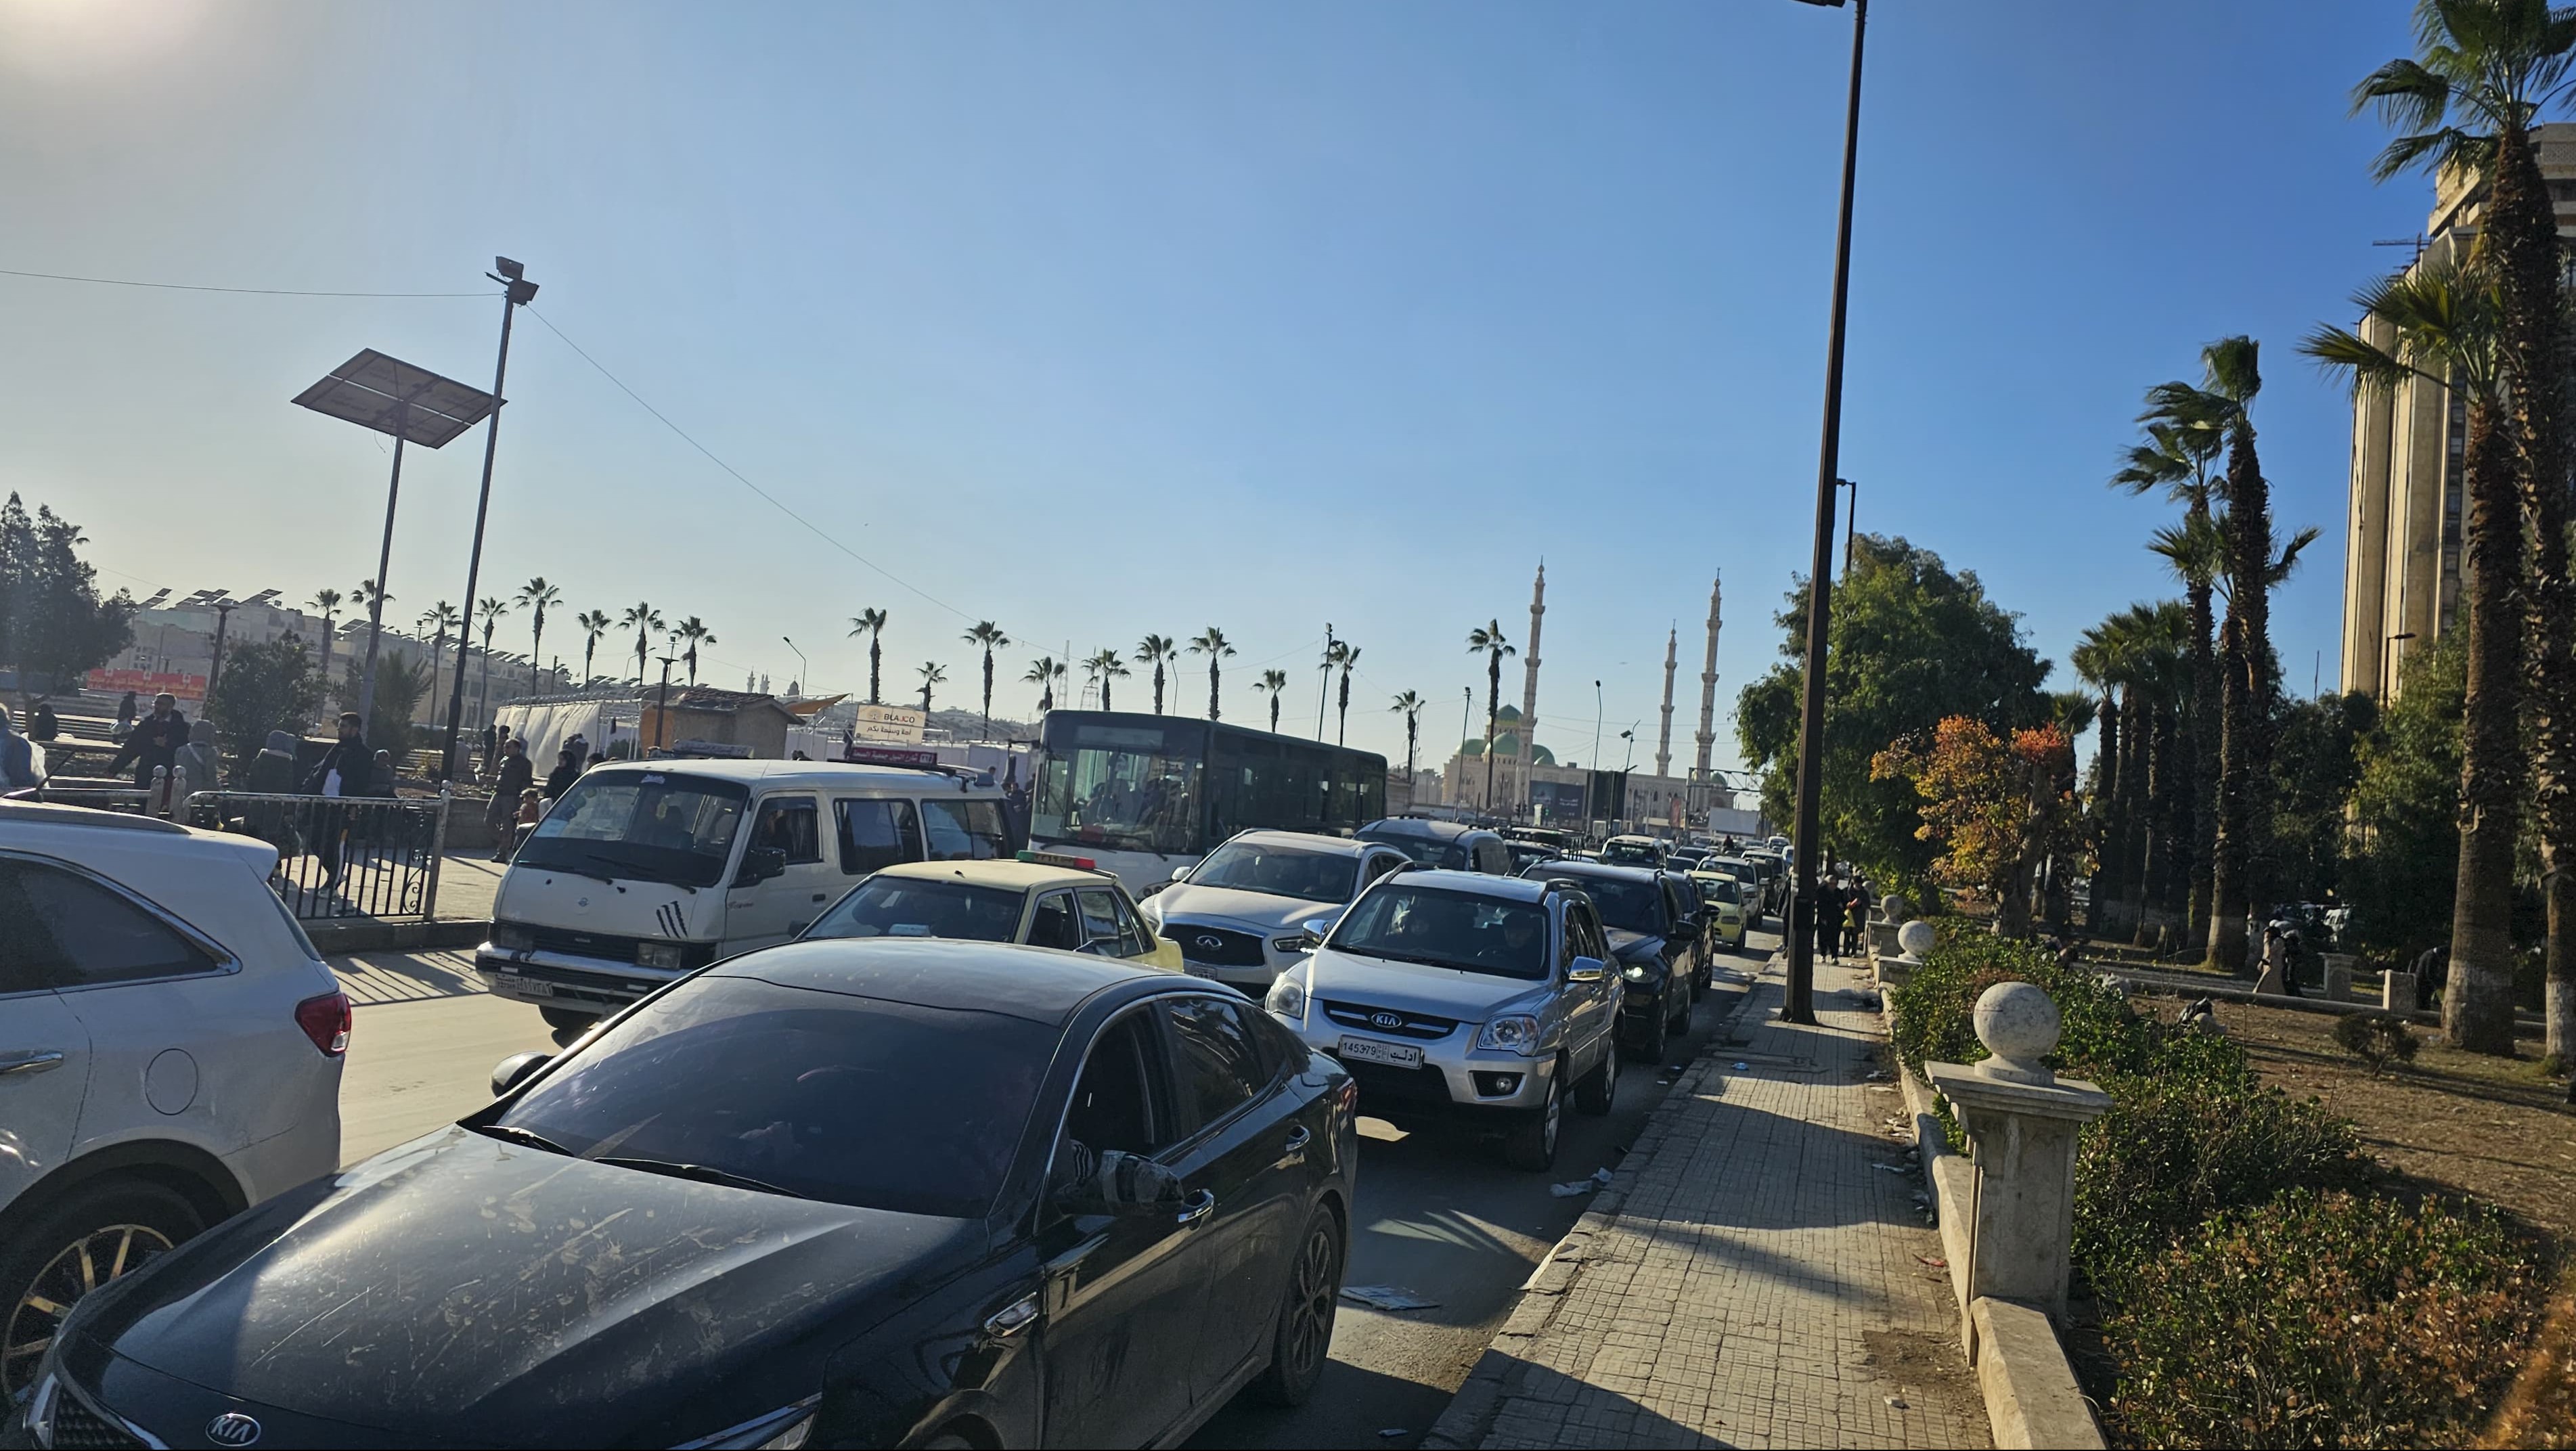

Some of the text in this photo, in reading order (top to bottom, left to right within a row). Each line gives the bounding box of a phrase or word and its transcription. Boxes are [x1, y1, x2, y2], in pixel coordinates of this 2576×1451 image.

[1376, 1014, 1396, 1026] KIA
[1343, 1042, 1377, 1056] 145379
[210, 1416, 252, 1442] KIA
